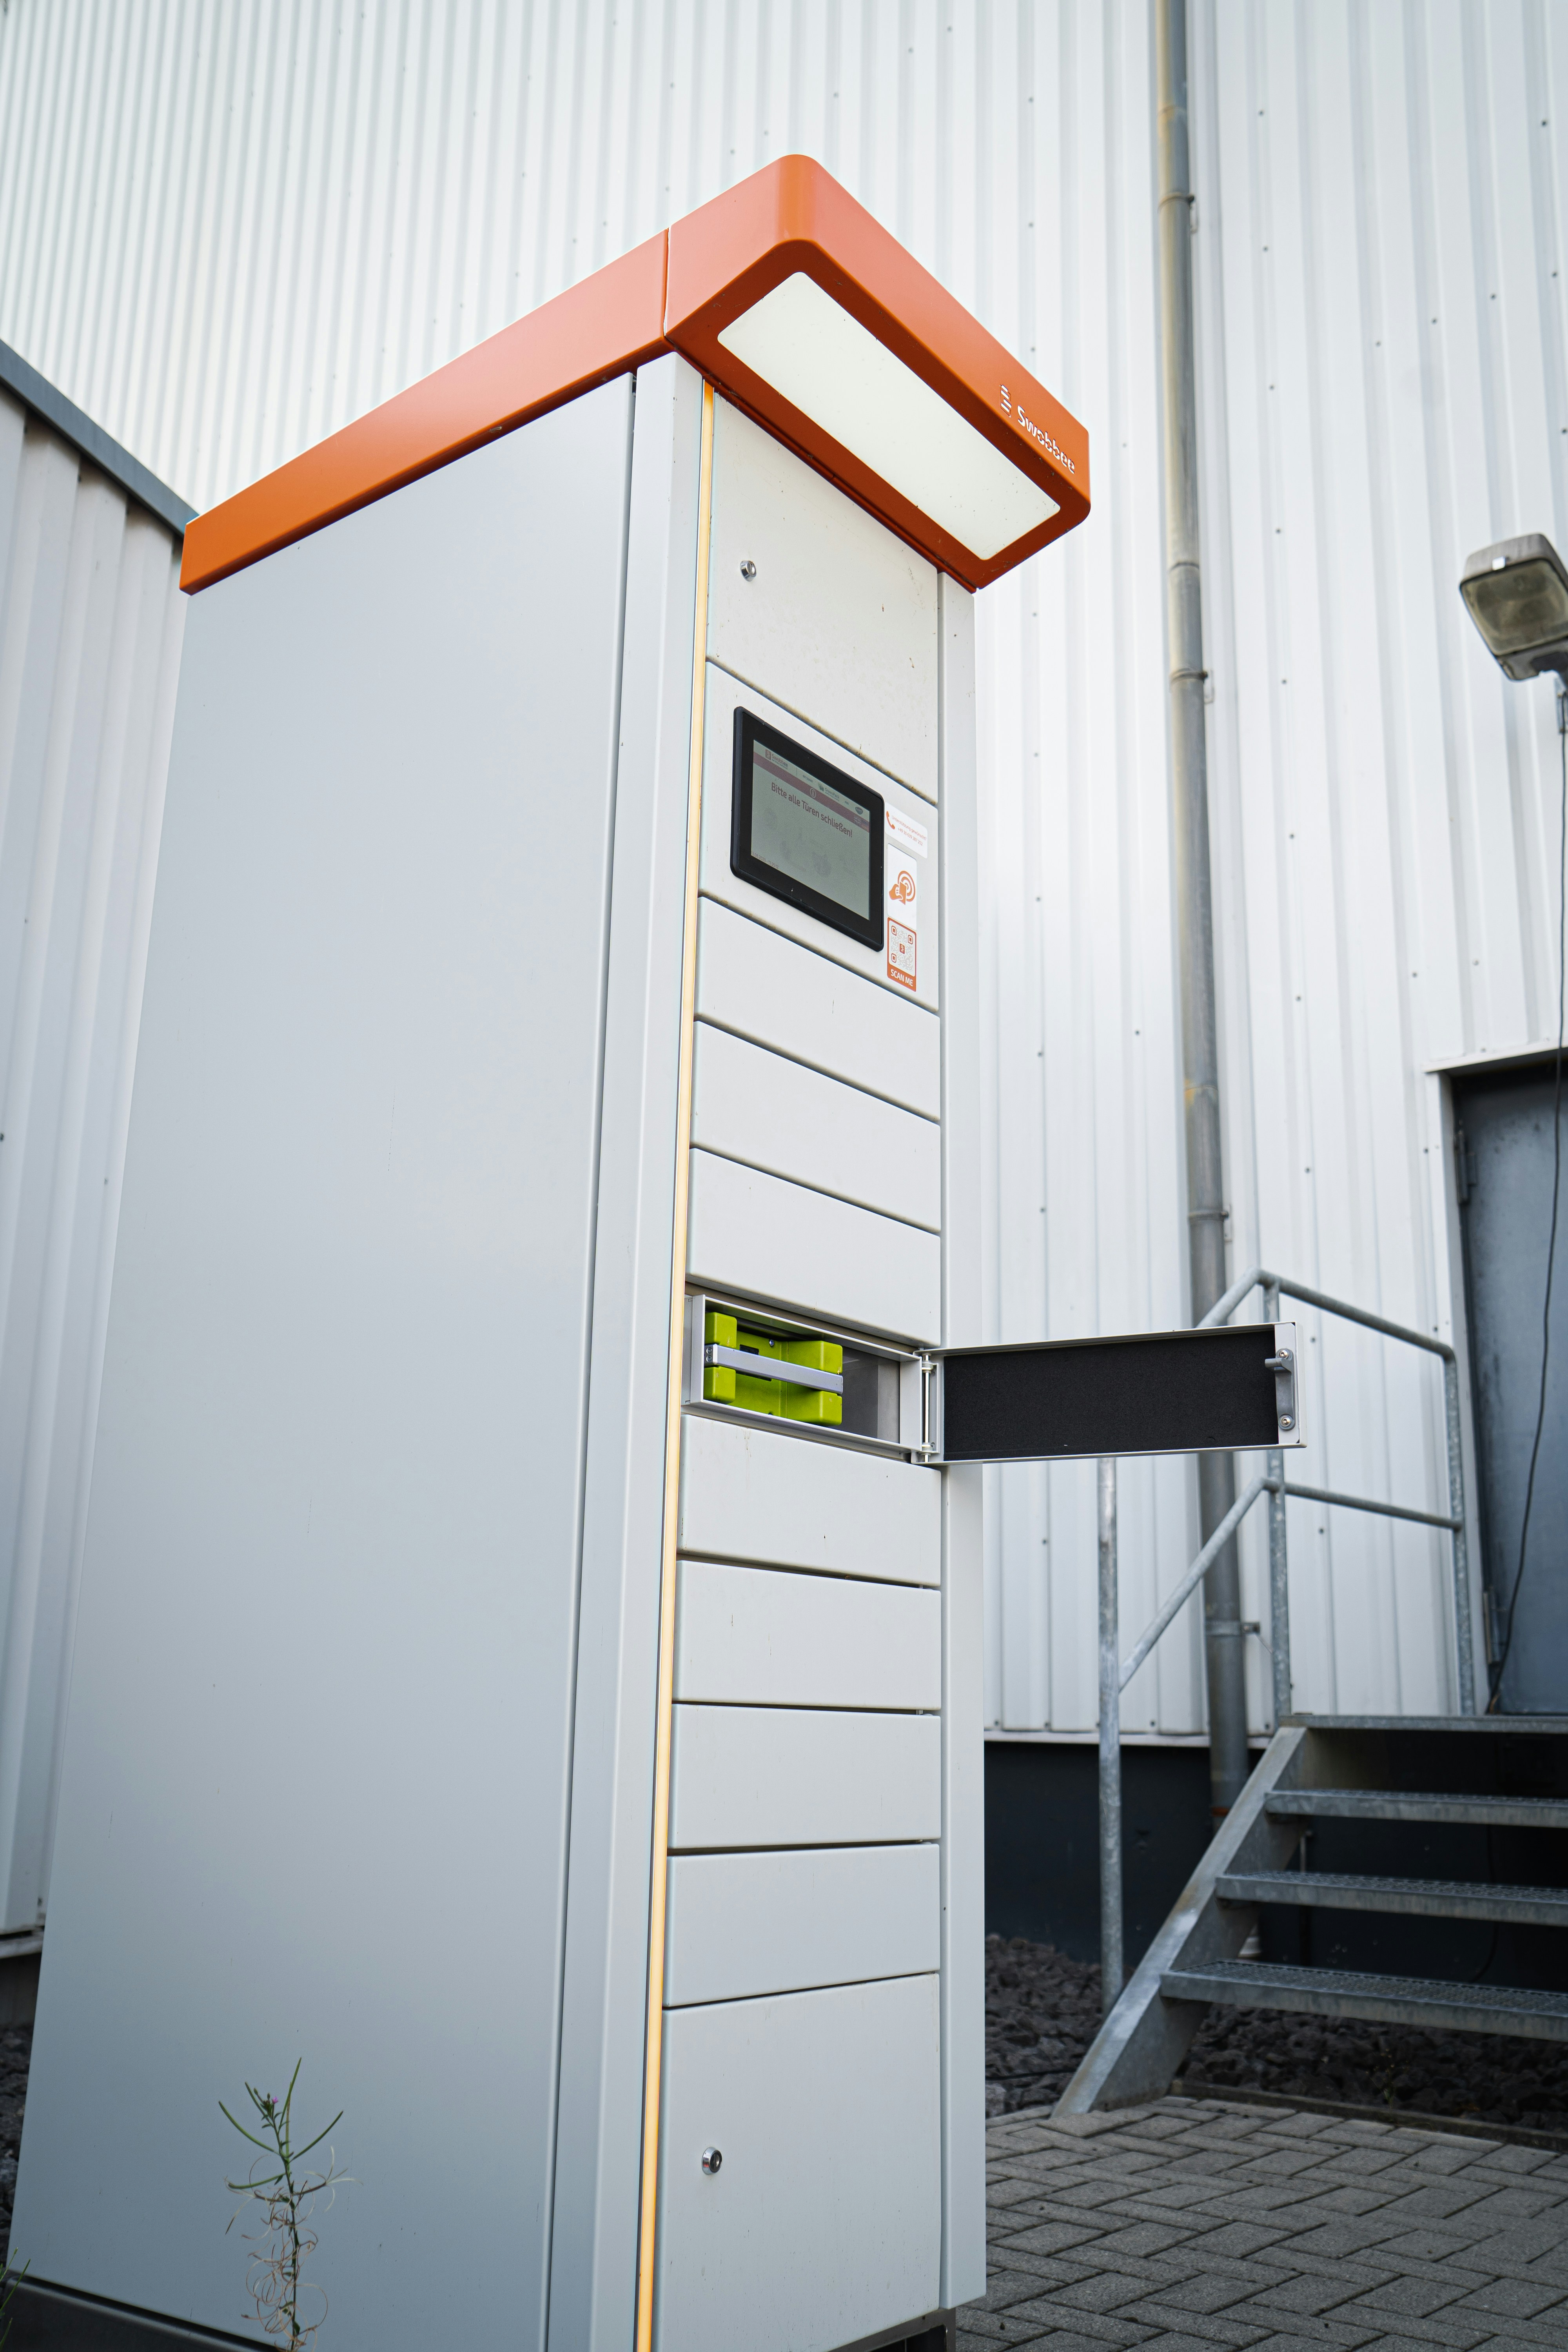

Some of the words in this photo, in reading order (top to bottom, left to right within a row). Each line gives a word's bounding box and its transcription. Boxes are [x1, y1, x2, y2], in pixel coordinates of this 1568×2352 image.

[1017, 405, 1075, 474] Swobbee
[772, 754, 788, 768] Swobbee
[771, 782, 787, 799] Bitte
[788, 794, 800, 807] alle
[802, 800, 820, 818] Türen
[821, 813, 853, 838] schließen!
[891, 815, 911, 831] Unterstützung
[891, 969, 904, 982] SCAN
[905, 976, 913, 987] ME
